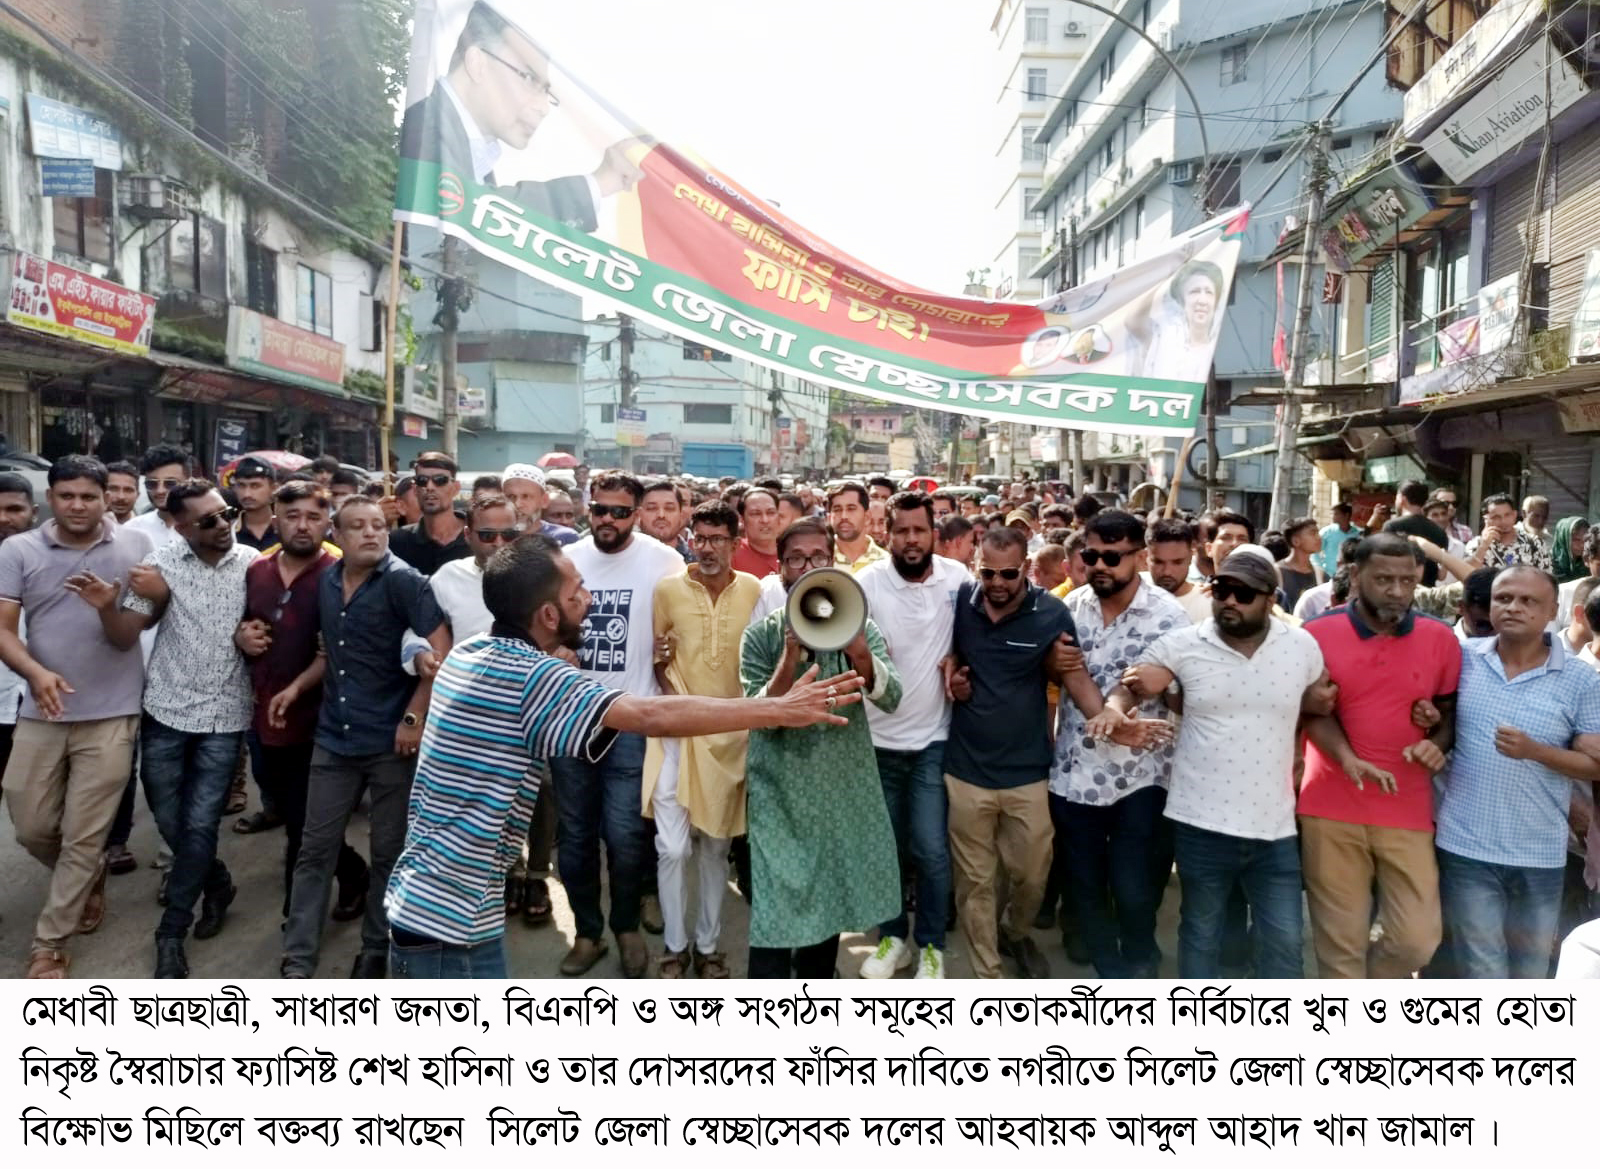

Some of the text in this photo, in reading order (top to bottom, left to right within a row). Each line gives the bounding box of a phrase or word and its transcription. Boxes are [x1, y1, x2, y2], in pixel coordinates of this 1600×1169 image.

[1443, 121, 1494, 158] Khan
[1488, 94, 1544, 137] Aviation
[731, 212, 811, 267] হাসিনা
[814, 262, 835, 279] ও
[472, 194, 1194, 420] সিলেট জেলা স্বেচ্ছাসেবক দল
[590, 591, 631, 606] AME
[581, 649, 626, 665] VER
